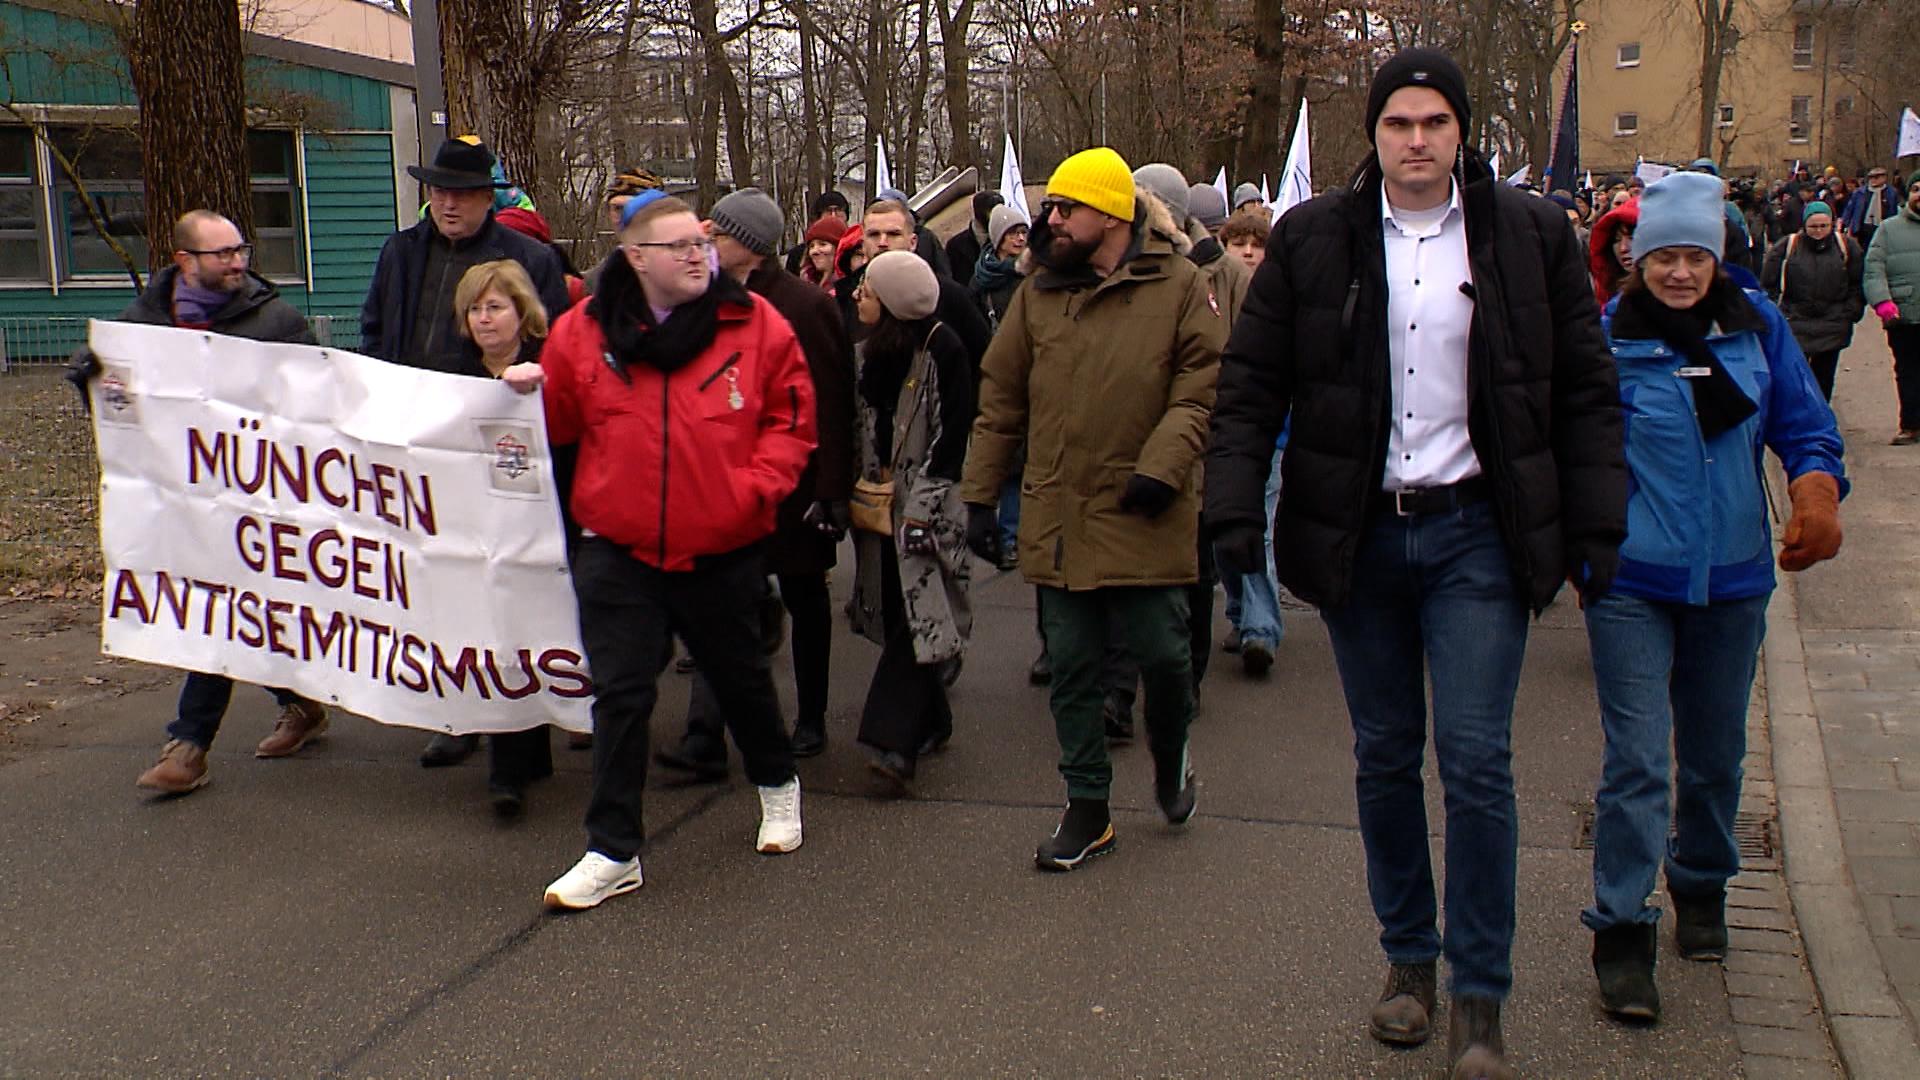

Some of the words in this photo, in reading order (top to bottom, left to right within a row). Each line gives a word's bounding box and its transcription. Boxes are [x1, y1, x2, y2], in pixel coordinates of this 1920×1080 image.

[187, 418, 437, 536] MÜNCHEN
[235, 515, 409, 610] GEGEN
[109, 568, 593, 700] ANTISEMITISMUS
